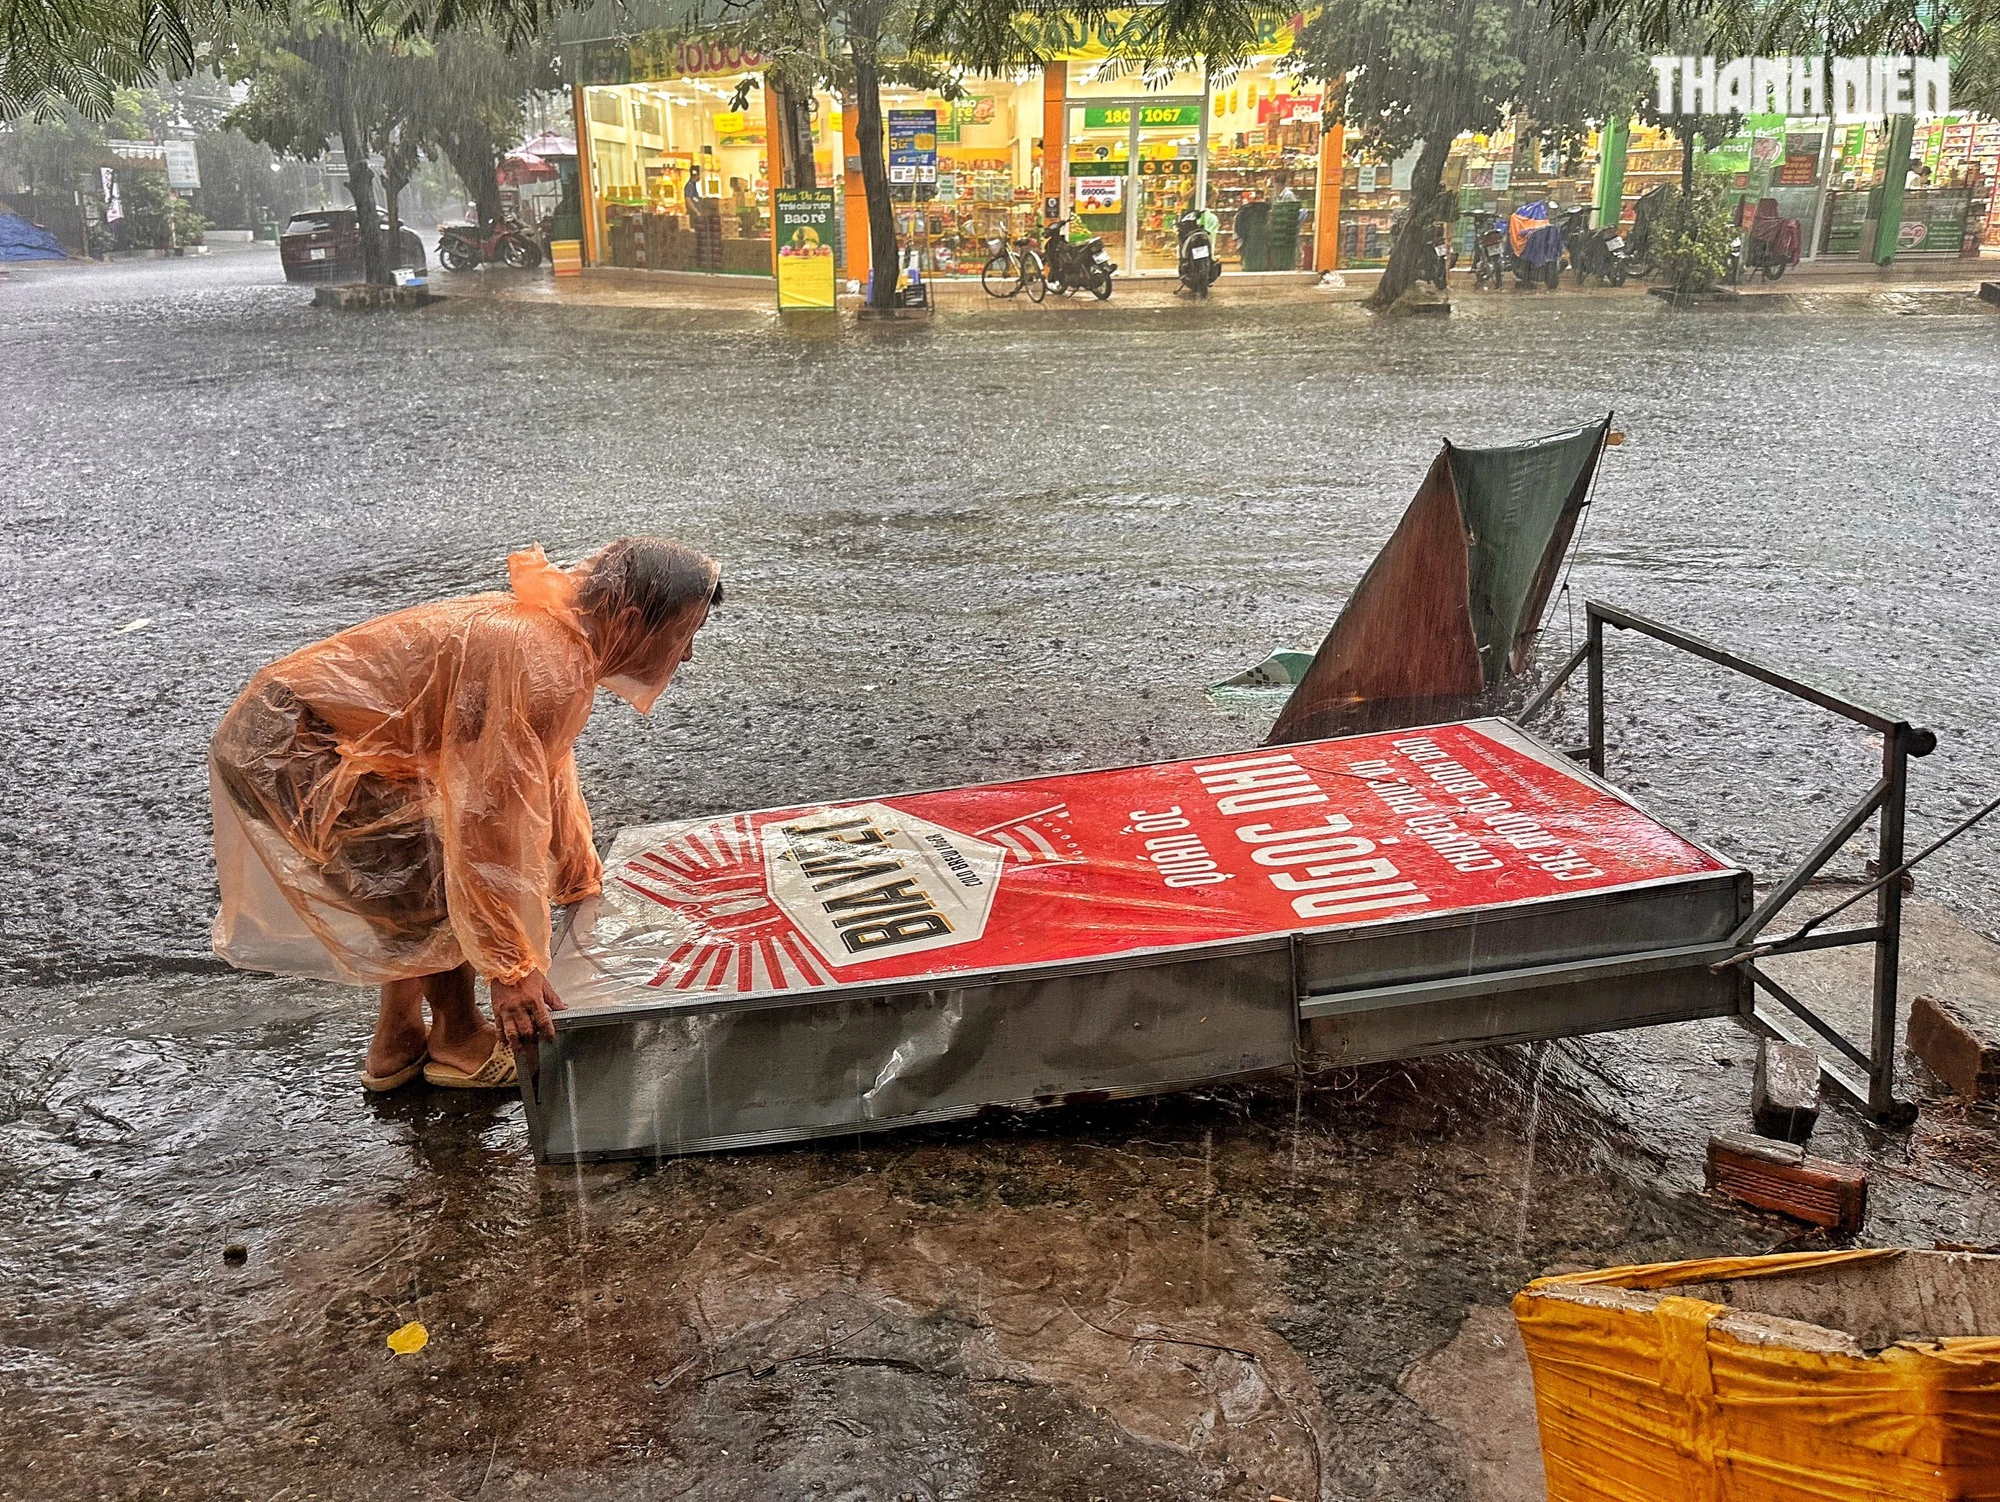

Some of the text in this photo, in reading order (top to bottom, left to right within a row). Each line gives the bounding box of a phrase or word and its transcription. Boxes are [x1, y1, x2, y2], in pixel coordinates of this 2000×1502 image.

[1105, 108, 1181, 124] 180 1067
[1418, 761, 1489, 795] BÌNH
[1193, 754, 1431, 919] NGỌC NHI
[1403, 814, 1504, 873] CHUYÊN
[940, 849, 969, 871] BREW
[1136, 834, 1235, 889] QUÁN
[1527, 848, 1605, 882] CÁC
[956, 870, 983, 887] COLD
[822, 877, 957, 953] BIA
